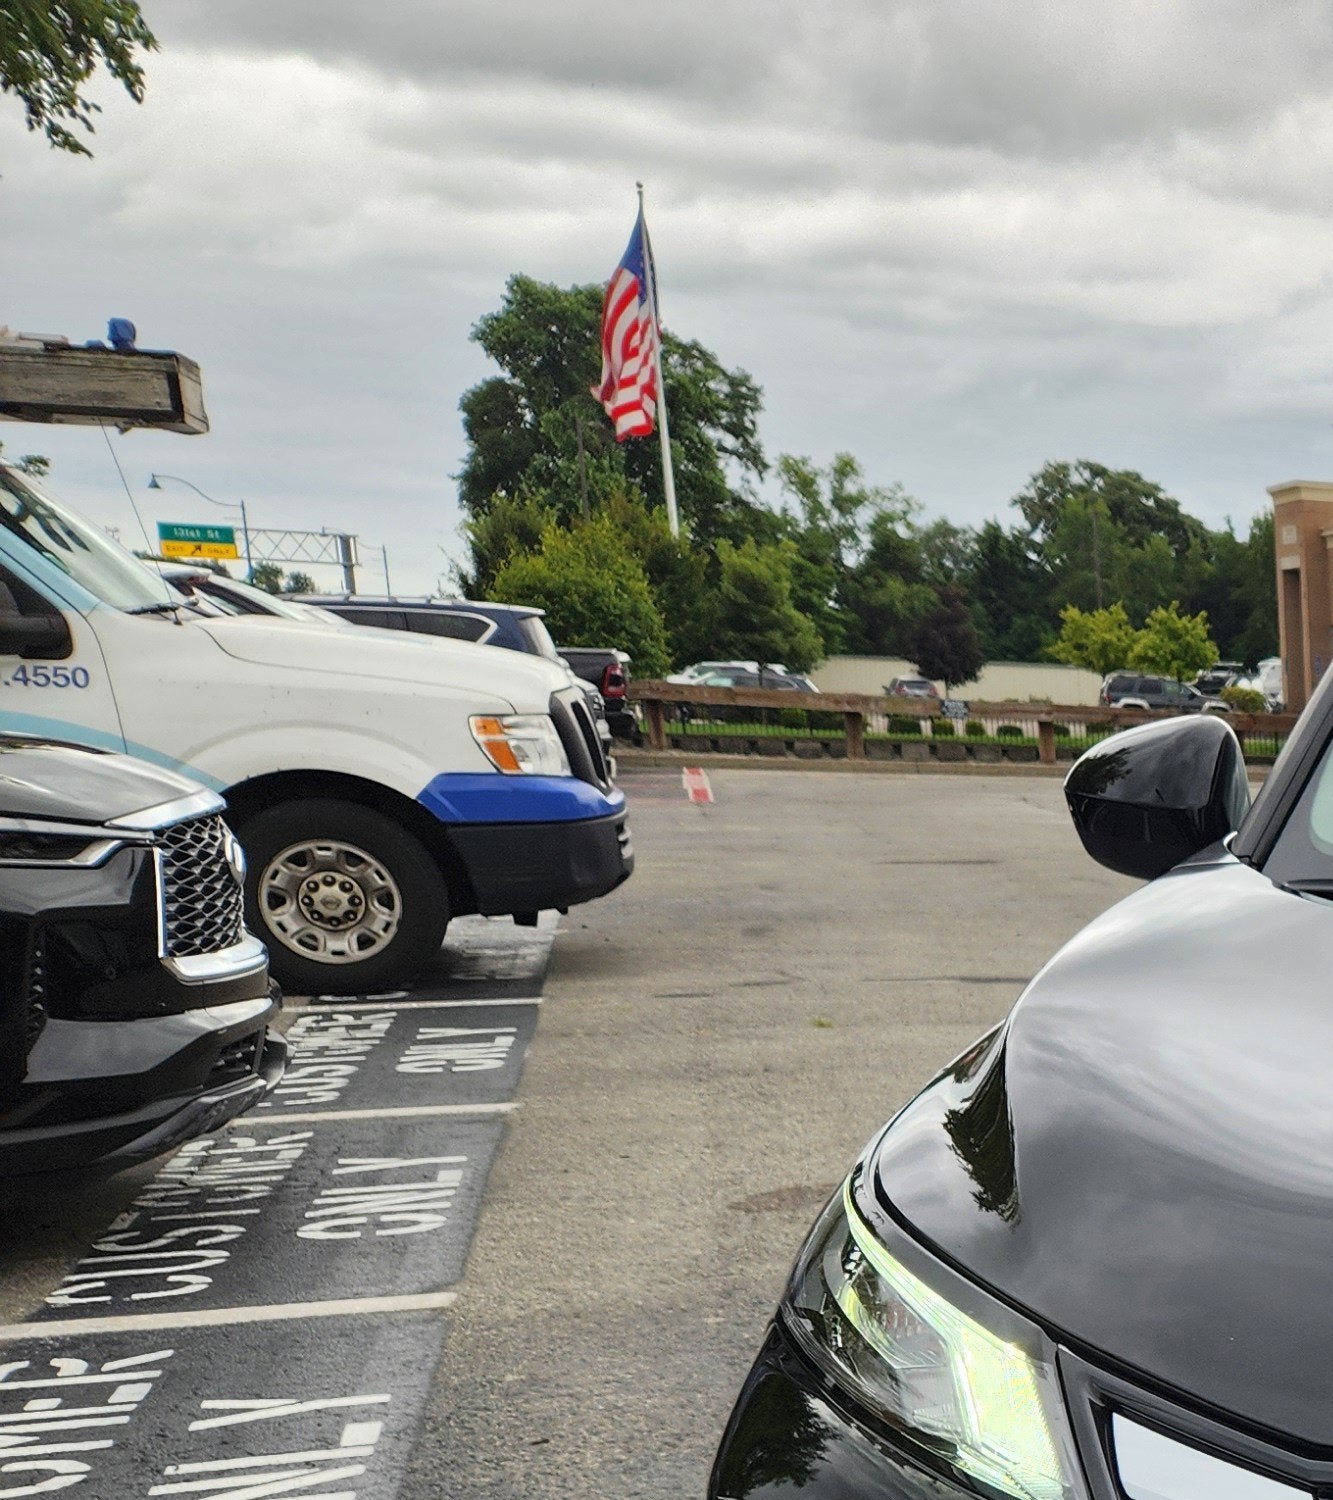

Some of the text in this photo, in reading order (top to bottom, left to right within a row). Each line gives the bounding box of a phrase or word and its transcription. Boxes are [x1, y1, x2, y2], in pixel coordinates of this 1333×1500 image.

[395, 1026, 518, 1073] ONLY
[44, 1131, 314, 1308] CUSTOMER
[296, 1155, 469, 1240] ONLY
